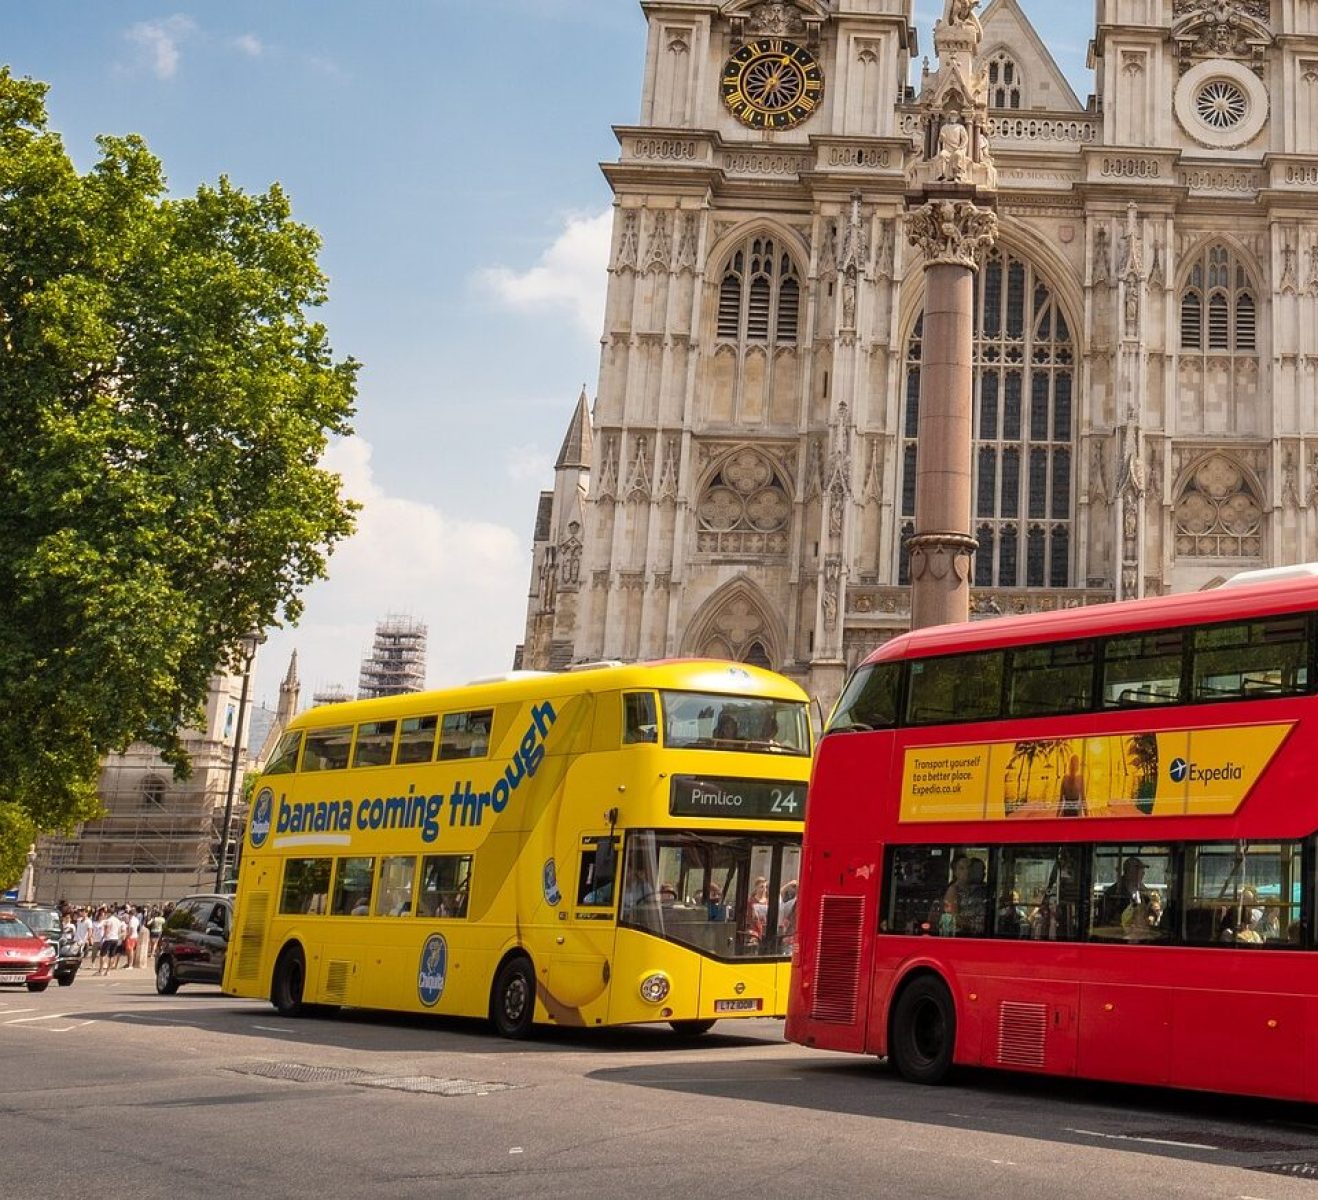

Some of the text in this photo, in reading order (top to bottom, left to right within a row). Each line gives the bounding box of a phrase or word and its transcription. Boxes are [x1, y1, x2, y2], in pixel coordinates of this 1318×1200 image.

[276, 701, 557, 843] banana coming through
[914, 755, 981, 770] Transport yourself
[913, 773, 921, 782] to
[928, 771, 950, 781] better
[952, 770, 973, 783] place.
[1189, 762, 1242, 786] Expedia
[912, 783, 961, 796] Expedia.co.uk
[691, 788, 798, 813] Pimlico 24
